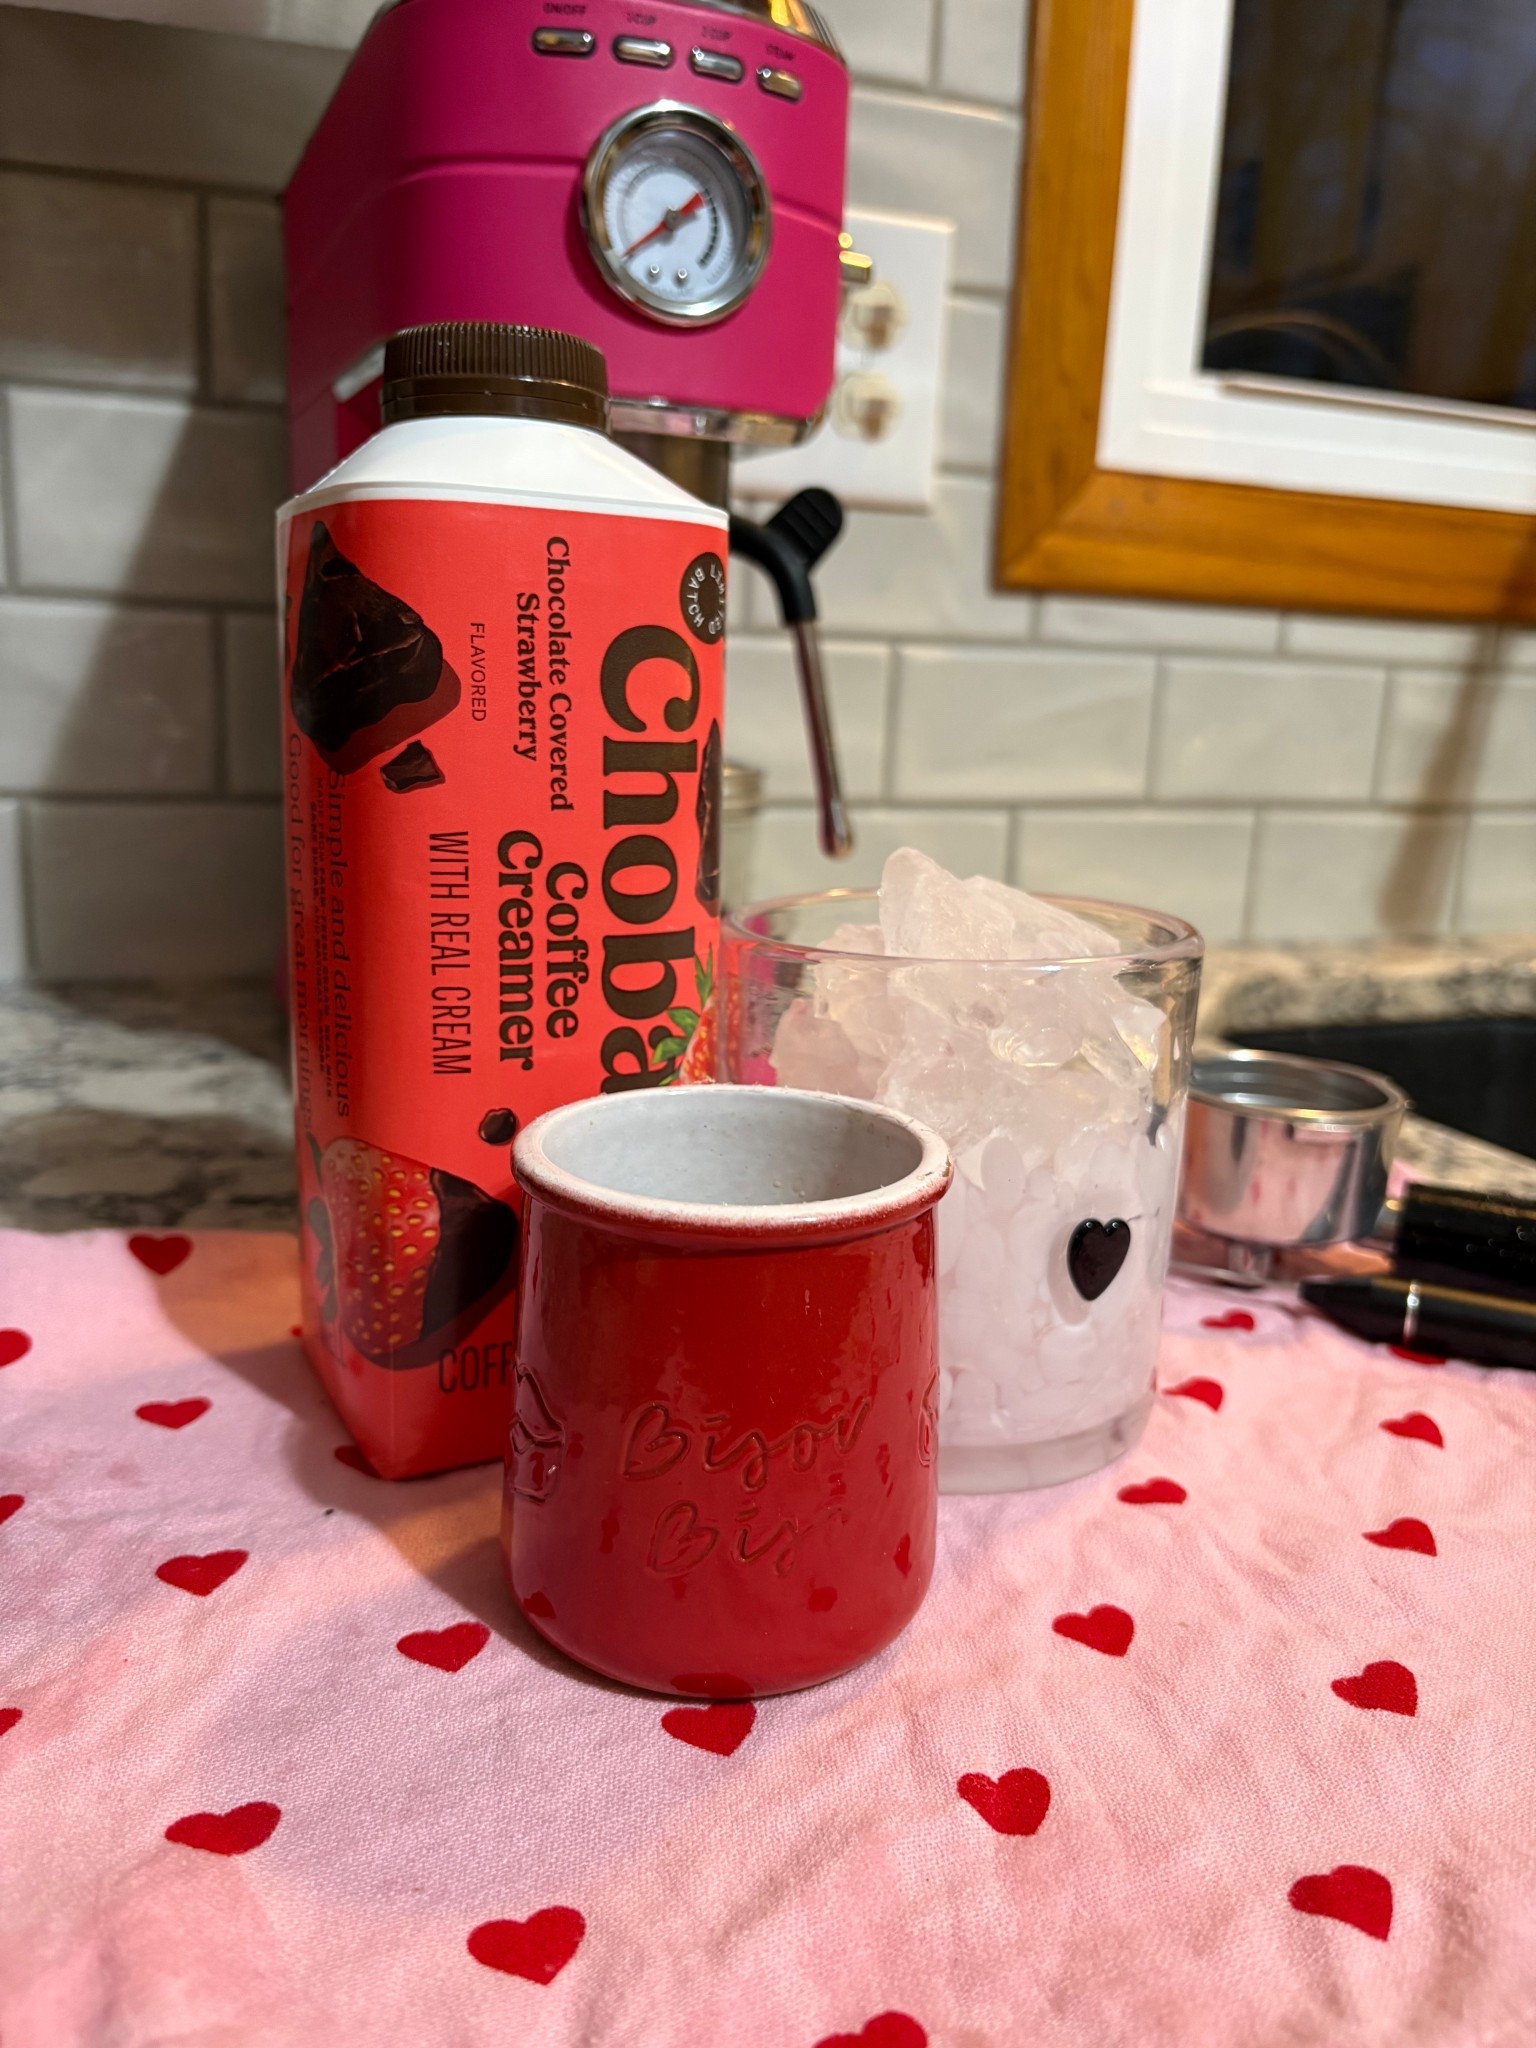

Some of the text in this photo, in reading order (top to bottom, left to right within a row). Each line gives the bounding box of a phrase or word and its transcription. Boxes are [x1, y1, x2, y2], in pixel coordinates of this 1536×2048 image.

[470, 622, 486, 721] FLAVORED
[513, 591, 542, 763] Strawberry
[546, 536, 574, 812] Chocolate Covered
[686, 567, 705, 628] BATCH
[289, 735, 304, 823] Good
[291, 835, 305, 876] for
[291, 887, 308, 968] great
[326, 768, 353, 1118] Simple and delicious
[429, 831, 472, 1075] WITH REAL CREAM
[497, 830, 544, 1071] Creamer
[545, 862, 590, 1039] Coffee
